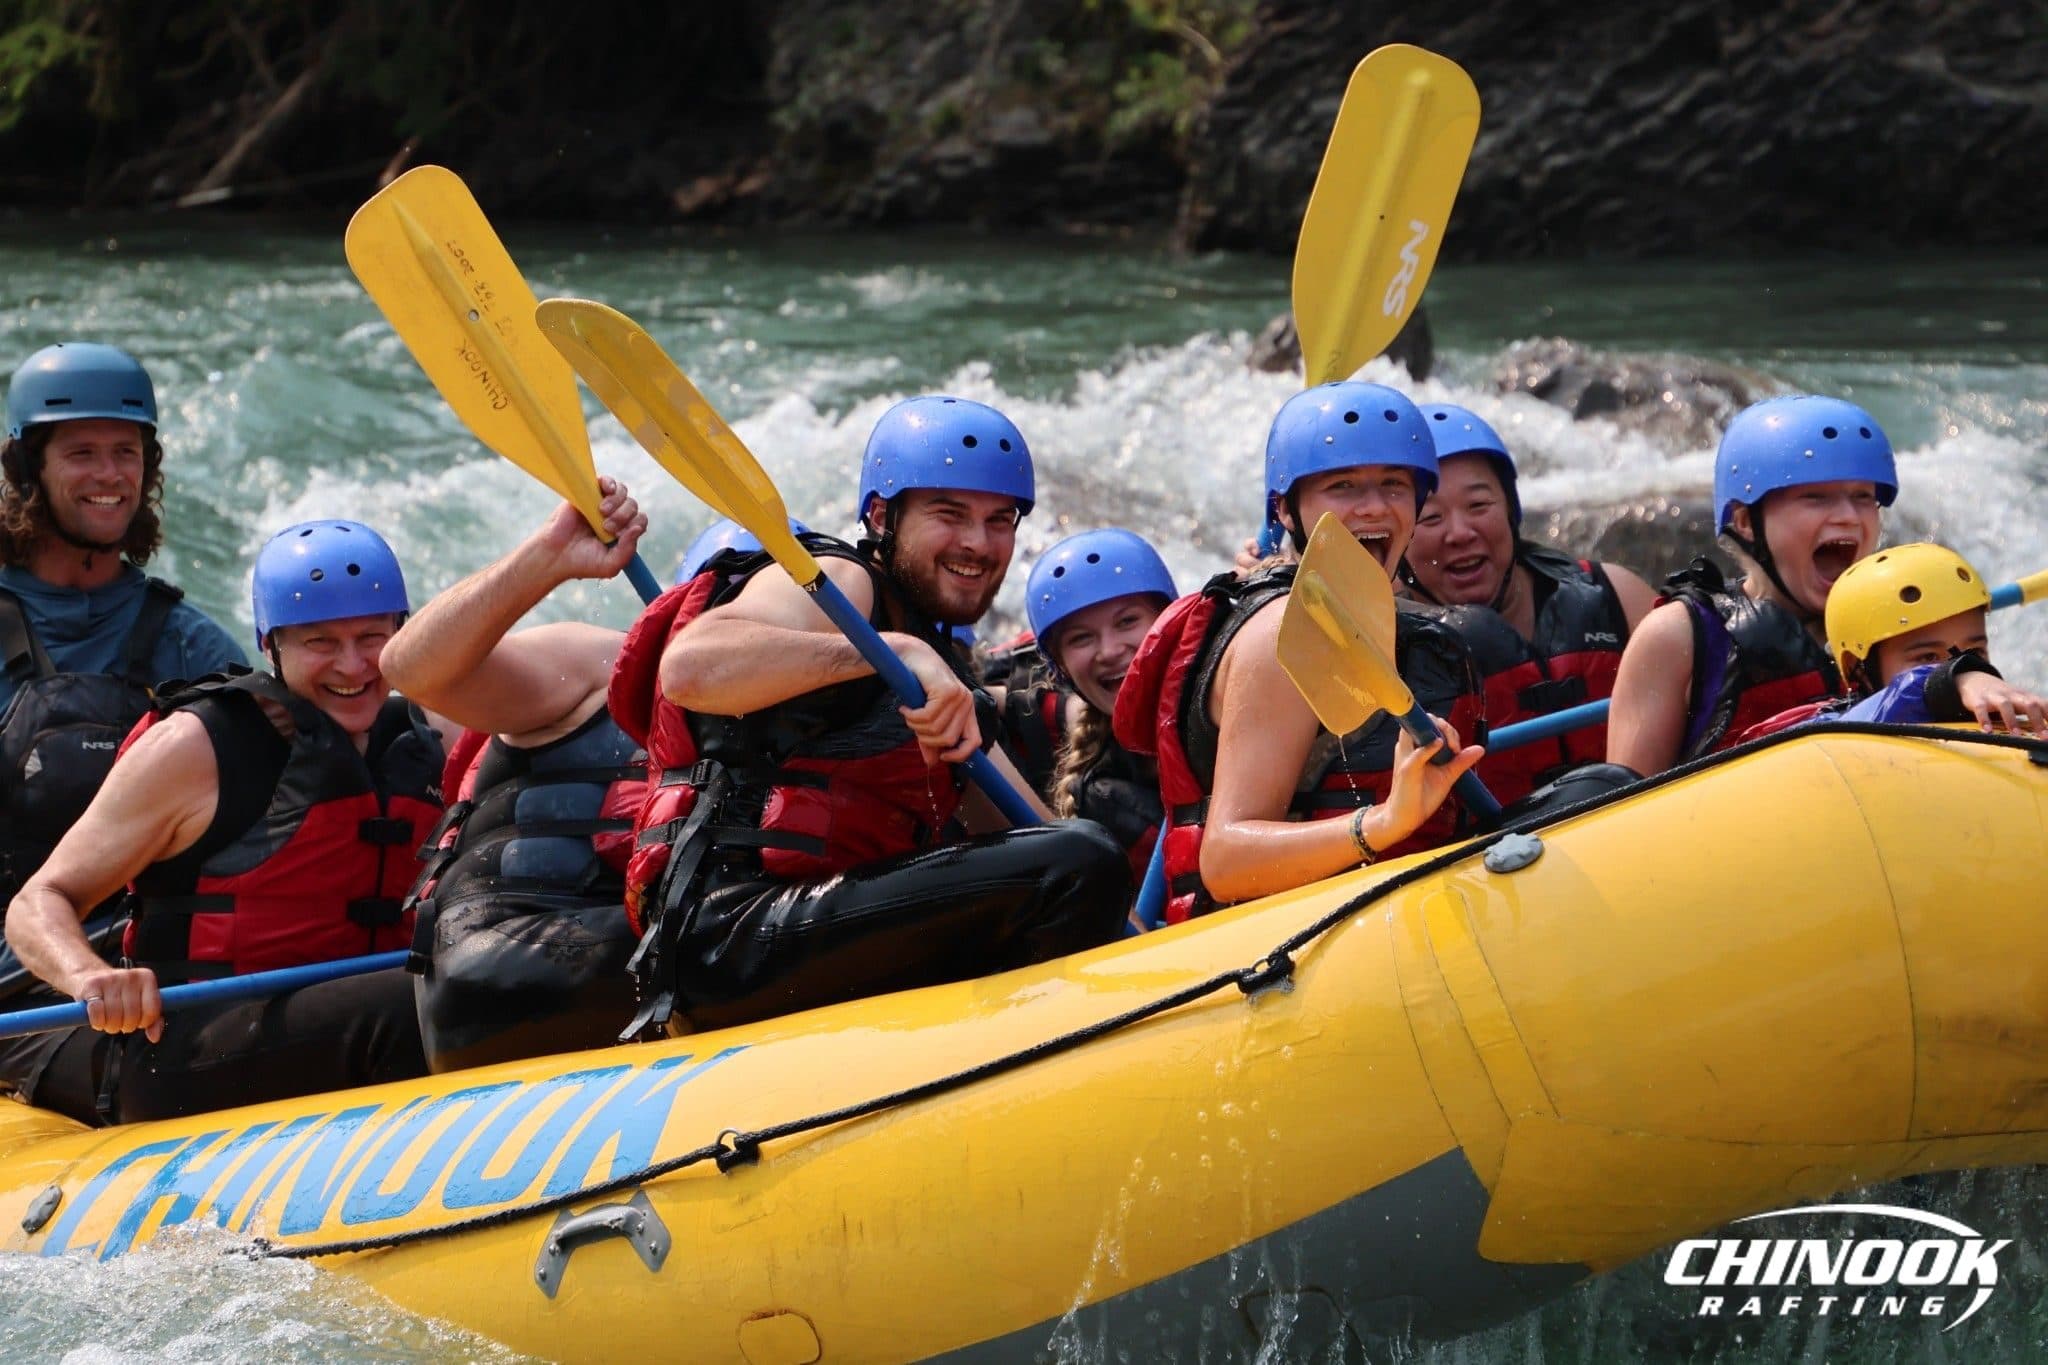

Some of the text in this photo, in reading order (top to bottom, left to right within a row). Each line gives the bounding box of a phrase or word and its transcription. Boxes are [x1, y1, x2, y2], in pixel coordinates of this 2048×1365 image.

[1383, 219, 1429, 319] NRS
[457, 337, 508, 410] CHINOOK
[1584, 632, 1619, 643] NRS
[82, 741, 116, 750] NRS
[40, 1045, 752, 1257] CHINOOK
